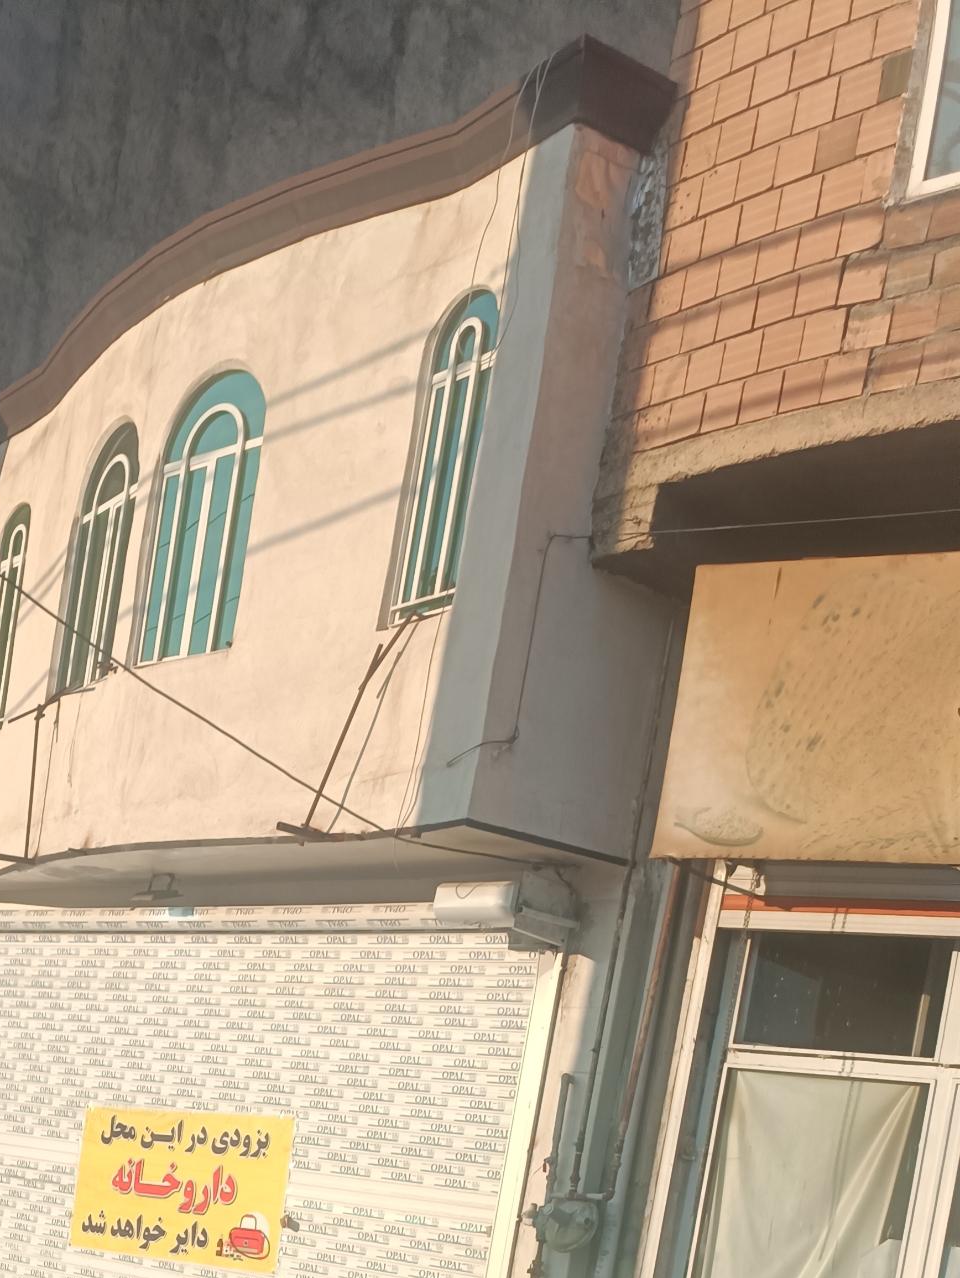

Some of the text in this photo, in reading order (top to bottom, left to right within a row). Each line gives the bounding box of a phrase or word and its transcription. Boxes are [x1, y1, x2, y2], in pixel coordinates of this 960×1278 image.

[377, 935, 452, 944] OPAL OPAL
[246, 962, 266, 970] OPAL
[293, 963, 314, 971] OPAL
[342, 964, 364, 972] OPAL
[394, 964, 417, 973] OPAL
[450, 965, 474, 974] OPAL
[384, 977, 407, 985] OPAL
[438, 978, 462, 986] OPAL
[375, 989, 397, 998] OPAL
[429, 991, 452, 1000] OPAL
[390, 1015, 468, 1026] OPAL OPAL
[439, 1005, 463, 1014] OPAL
[104, 1015, 498, 1042] OPAL OPAL OPAL OPAL OPAL OPAL OPAL
[281, 1036, 302, 1044] OPAL
[329, 1038, 350, 1047] OPAL
[378, 1041, 401, 1050] OPAL
[431, 1043, 455, 1053] OPAL
[254, 1046, 477, 1068] OPAL OPAL OPAL OPAL OPAL
[289, 1061, 465, 1080] OPAL OPAL OPAL OPAL
[252, 1070, 272, 1079] OPAL
[298, 1074, 319, 1083] OPAL
[346, 1077, 368, 1087] OPAL
[397, 1081, 420, 1091] OPAL
[451, 1085, 476, 1095] OPAL
[222, 1080, 494, 1110] OPAL OPAL OPAL OPAL OPAL OPAL
[112, 1093, 454, 1133] OPAL OPAL OPAL OPAL OPAL
[218, 1092, 489, 1123] OPAL OPAL OPAL OPAL OPAL OPAL
[100, 1114, 270, 1157] بزودی در این محل
[316, 1125, 442, 1145] OPAL OPAL OPAL
[46, 1129, 62, 1137] OPAL
[339, 1165, 361, 1175] OPAL
[390, 1171, 413, 1182] OPAL
[444, 1178, 468, 1189] OPAL
[326, 1151, 454, 1174] OPAL OPAL OPAL
[349, 1141, 479, 1163] OPAL OPAL OPAL
[16, 1160, 31, 1168] OPAL
[302, 1199, 323, 1210] OPAL
[352, 1206, 374, 1217] OPAL
[404, 1214, 428, 1225] OPAL
[111, 1158, 238, 1215] داروخانه
[42, 1195, 463, 1271] OPAL OPAL OPAL OPAL
[81, 1210, 209, 1255] دایر خواهد شد
[332, 1217, 461, 1244] OPAL OPAL OPAL
[298, 1262, 319, 1273] OPAL
[316, 1252, 337, 1263] OPAL
[366, 1260, 388, 1272] OPAL
[30, 1269, 45, 1278] OPAL
